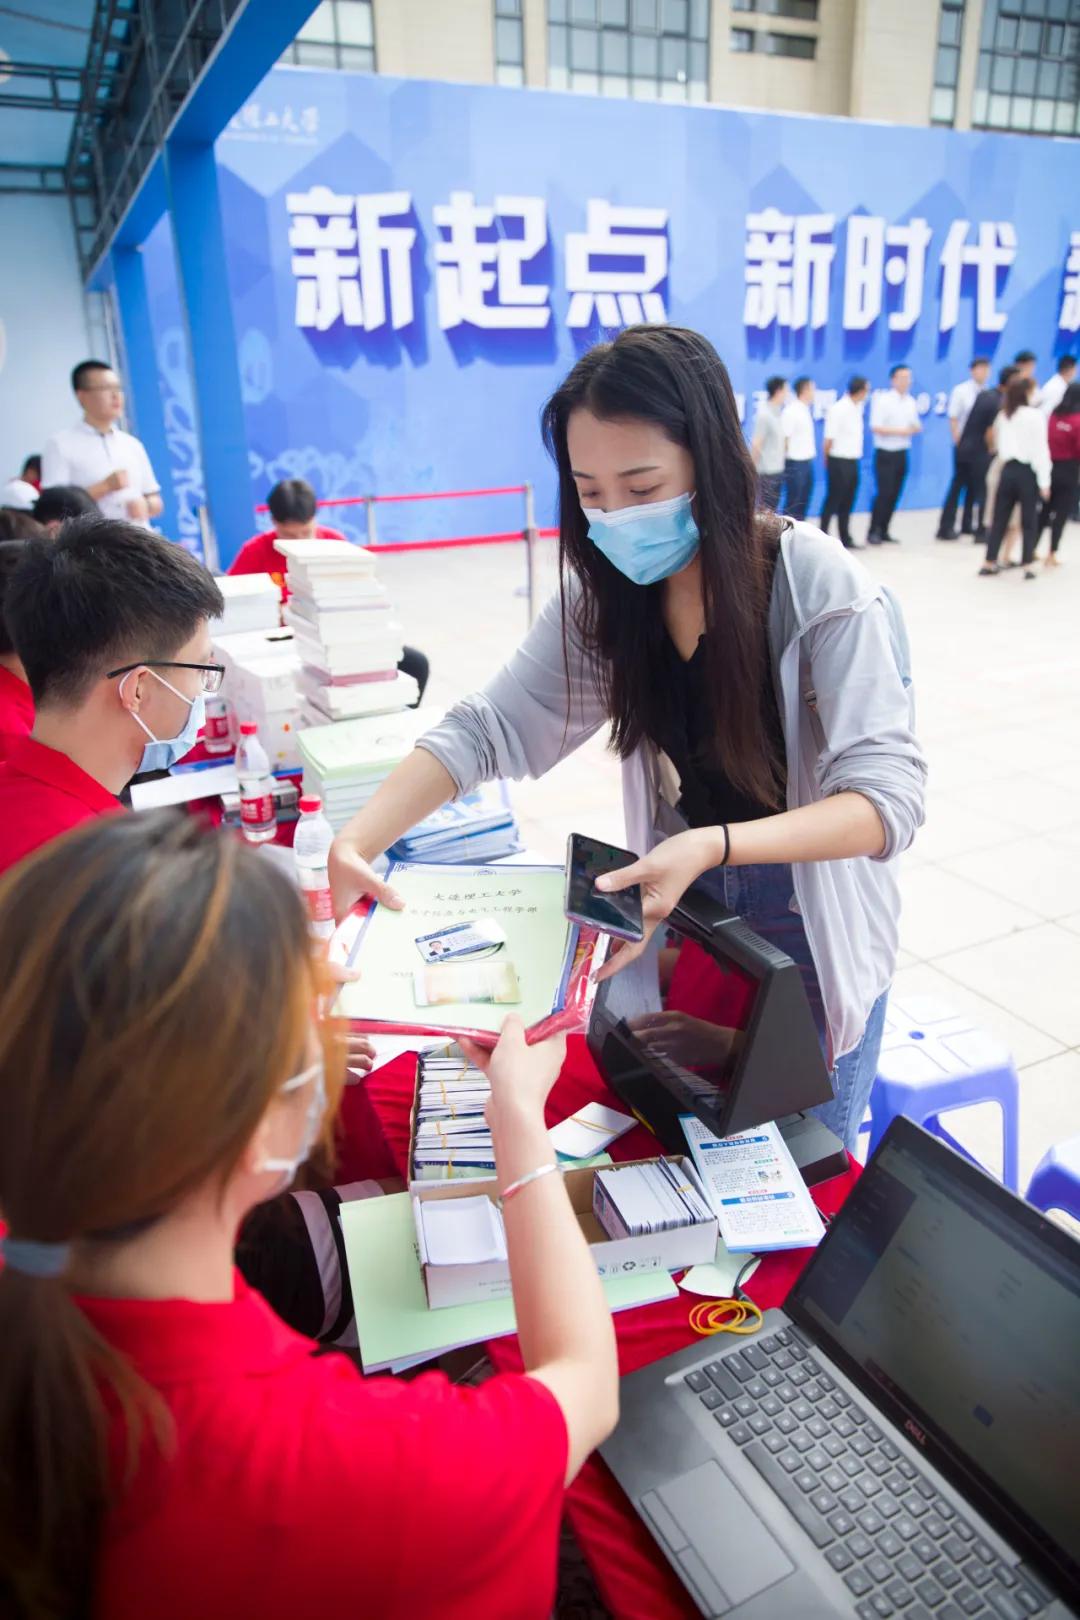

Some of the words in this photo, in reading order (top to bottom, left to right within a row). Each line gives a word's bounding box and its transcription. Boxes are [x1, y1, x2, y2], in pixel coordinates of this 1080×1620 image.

[286, 186, 670, 331] 新起点
[744, 207, 1017, 332] 新时代
[904, 1419, 927, 1446] DELL
